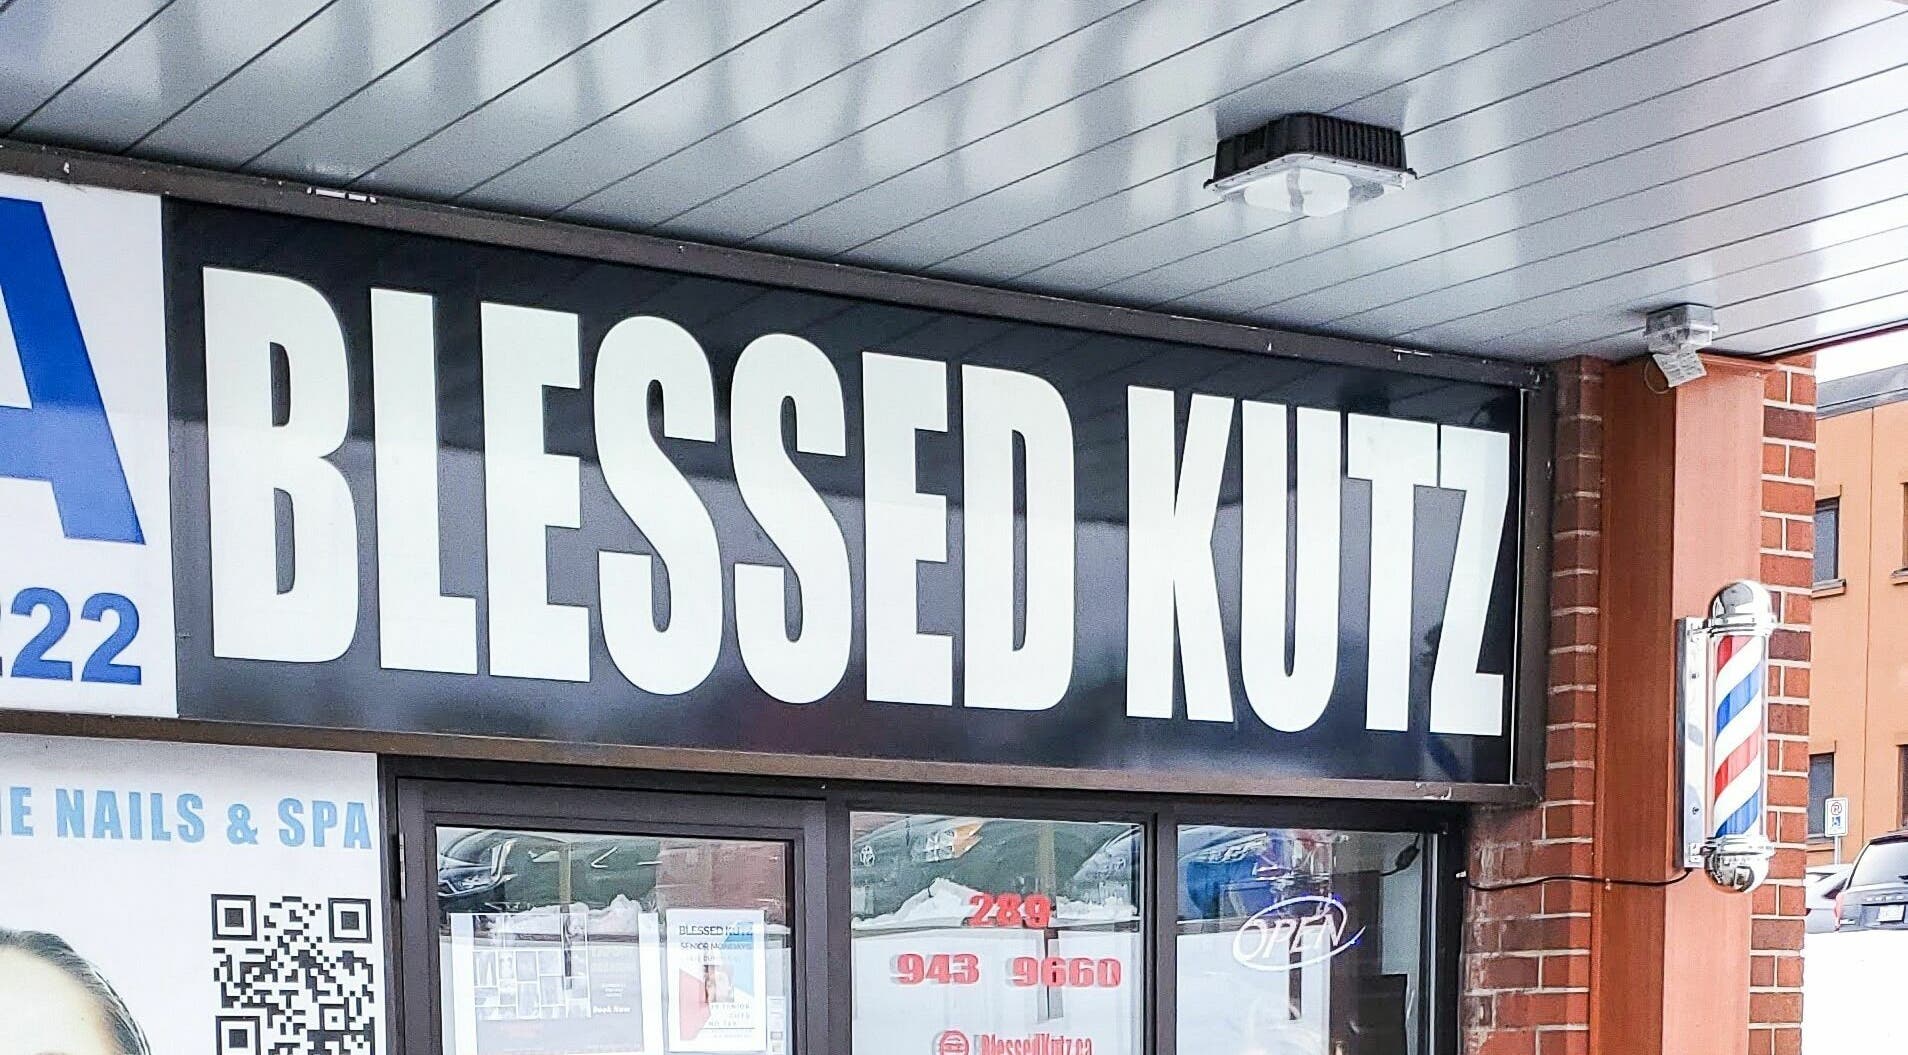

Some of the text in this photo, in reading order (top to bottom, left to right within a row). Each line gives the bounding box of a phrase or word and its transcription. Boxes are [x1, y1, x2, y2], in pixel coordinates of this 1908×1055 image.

[203, 267, 1511, 736] BLESSED KUTZ
[0, 586, 142, 686] 22
[0, 786, 373, 850] E NAILS & SPA
[678, 925, 724, 937] BLESSED
[966, 891, 1053, 929] 289
[1232, 908, 1348, 960] OPEN
[896, 953, 1122, 988] 943 9660
